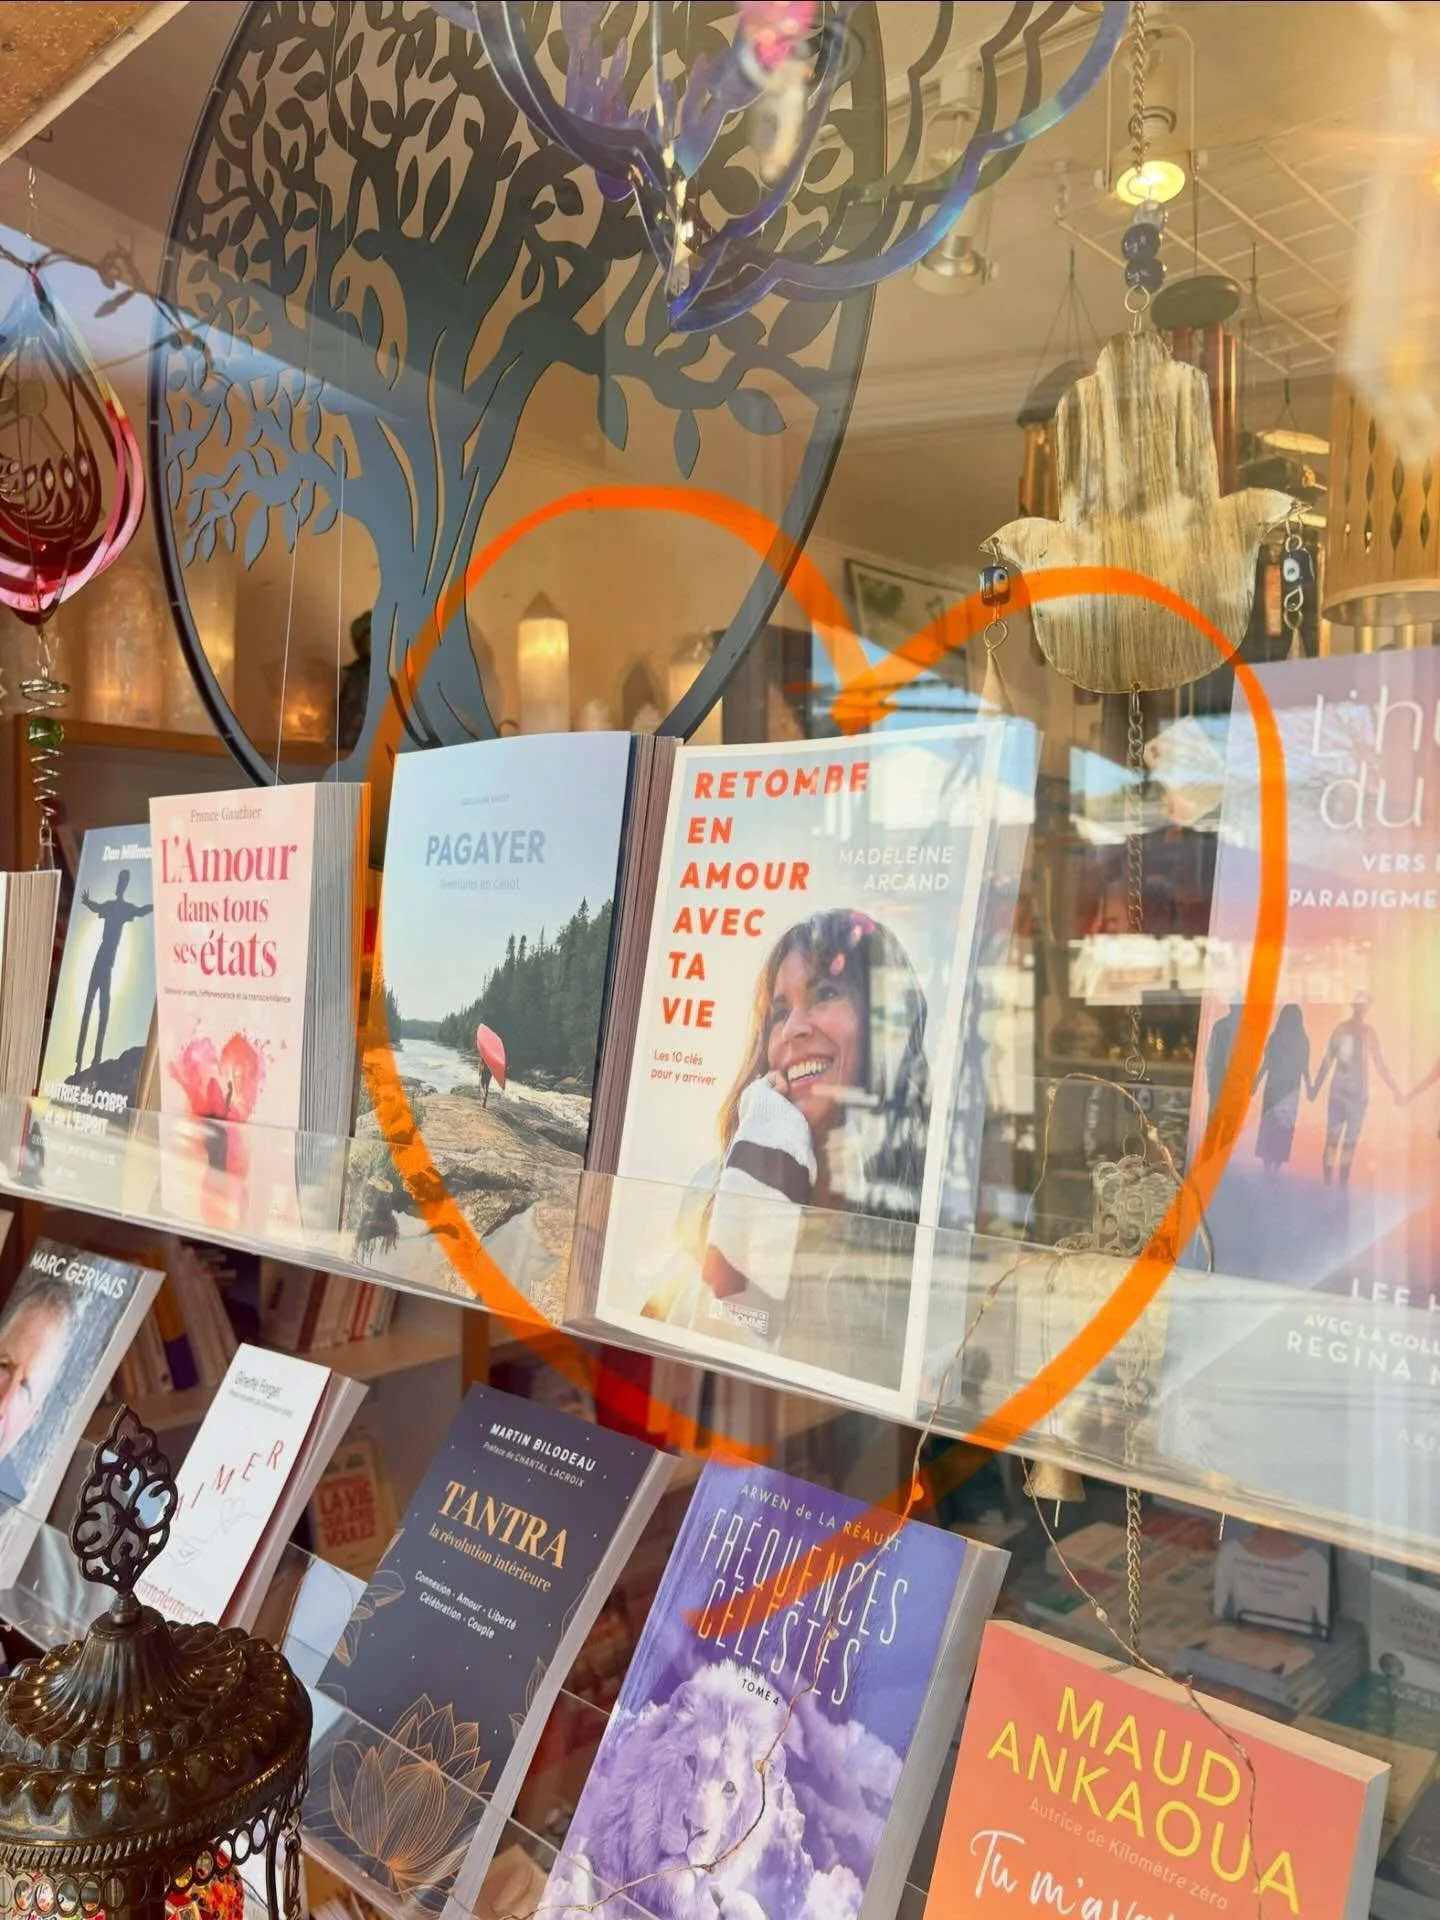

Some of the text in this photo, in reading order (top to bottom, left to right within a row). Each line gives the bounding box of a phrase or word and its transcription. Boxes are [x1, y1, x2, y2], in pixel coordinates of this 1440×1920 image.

[694, 762, 870, 799] RETOMBE
[1320, 761, 1424, 830] du
[190, 806, 263, 823] France Gauthier
[688, 816, 733, 844] EN
[103, 845, 121, 861] Dan
[161, 835, 298, 884] L'Amour
[425, 830, 546, 866] PAGAYER
[839, 847, 954, 866] MADELEINE
[1362, 854, 1425, 873] VERS
[680, 861, 811, 890] AMOUR
[864, 873, 950, 891] ARCAND
[177, 893, 269, 925] dans tous
[1289, 889, 1438, 909] PARADIGME
[673, 908, 766, 937] AVEC
[174, 929, 278, 978] ses états
[669, 952, 706, 980] TA
[662, 997, 716, 1028] VIE
[654, 1049, 704, 1065] Les 10 clés
[651, 1068, 717, 1086] pour y arriver
[30, 1252, 128, 1299] MARC GERVAIS
[1304, 1314, 1353, 1337] AVEC
[1358, 1324, 1382, 1343] LA
[1287, 1330, 1411, 1380] REGINA
[490, 1424, 596, 1472] MARTIN BILODEAU
[515, 1453, 548, 1474] CHANTAL
[549, 1468, 585, 1487] LACROIX
[741, 1483, 790, 1512] ARWEN
[796, 1504, 813, 1520] de
[819, 1512, 836, 1529] LA
[437, 1480, 568, 1569] TANTRA
[429, 1523, 552, 1593] la révolution intérieure
[701, 1508, 908, 1645] FRÉQUENCES
[415, 1570, 517, 1630] Connexion Amour Liberté
[420, 1591, 495, 1639] Célébration Couple
[698, 1578, 861, 1706] CÉLESTES
[741, 1679, 771, 1702] TOME
[1056, 1686, 1242, 1807] MAUD
[987, 1721, 1300, 1914] ANKAOUA
[970, 1829, 1025, 1899] Tu
[1030, 1796, 1229, 1911] Autrice de Kilomètre zéro
